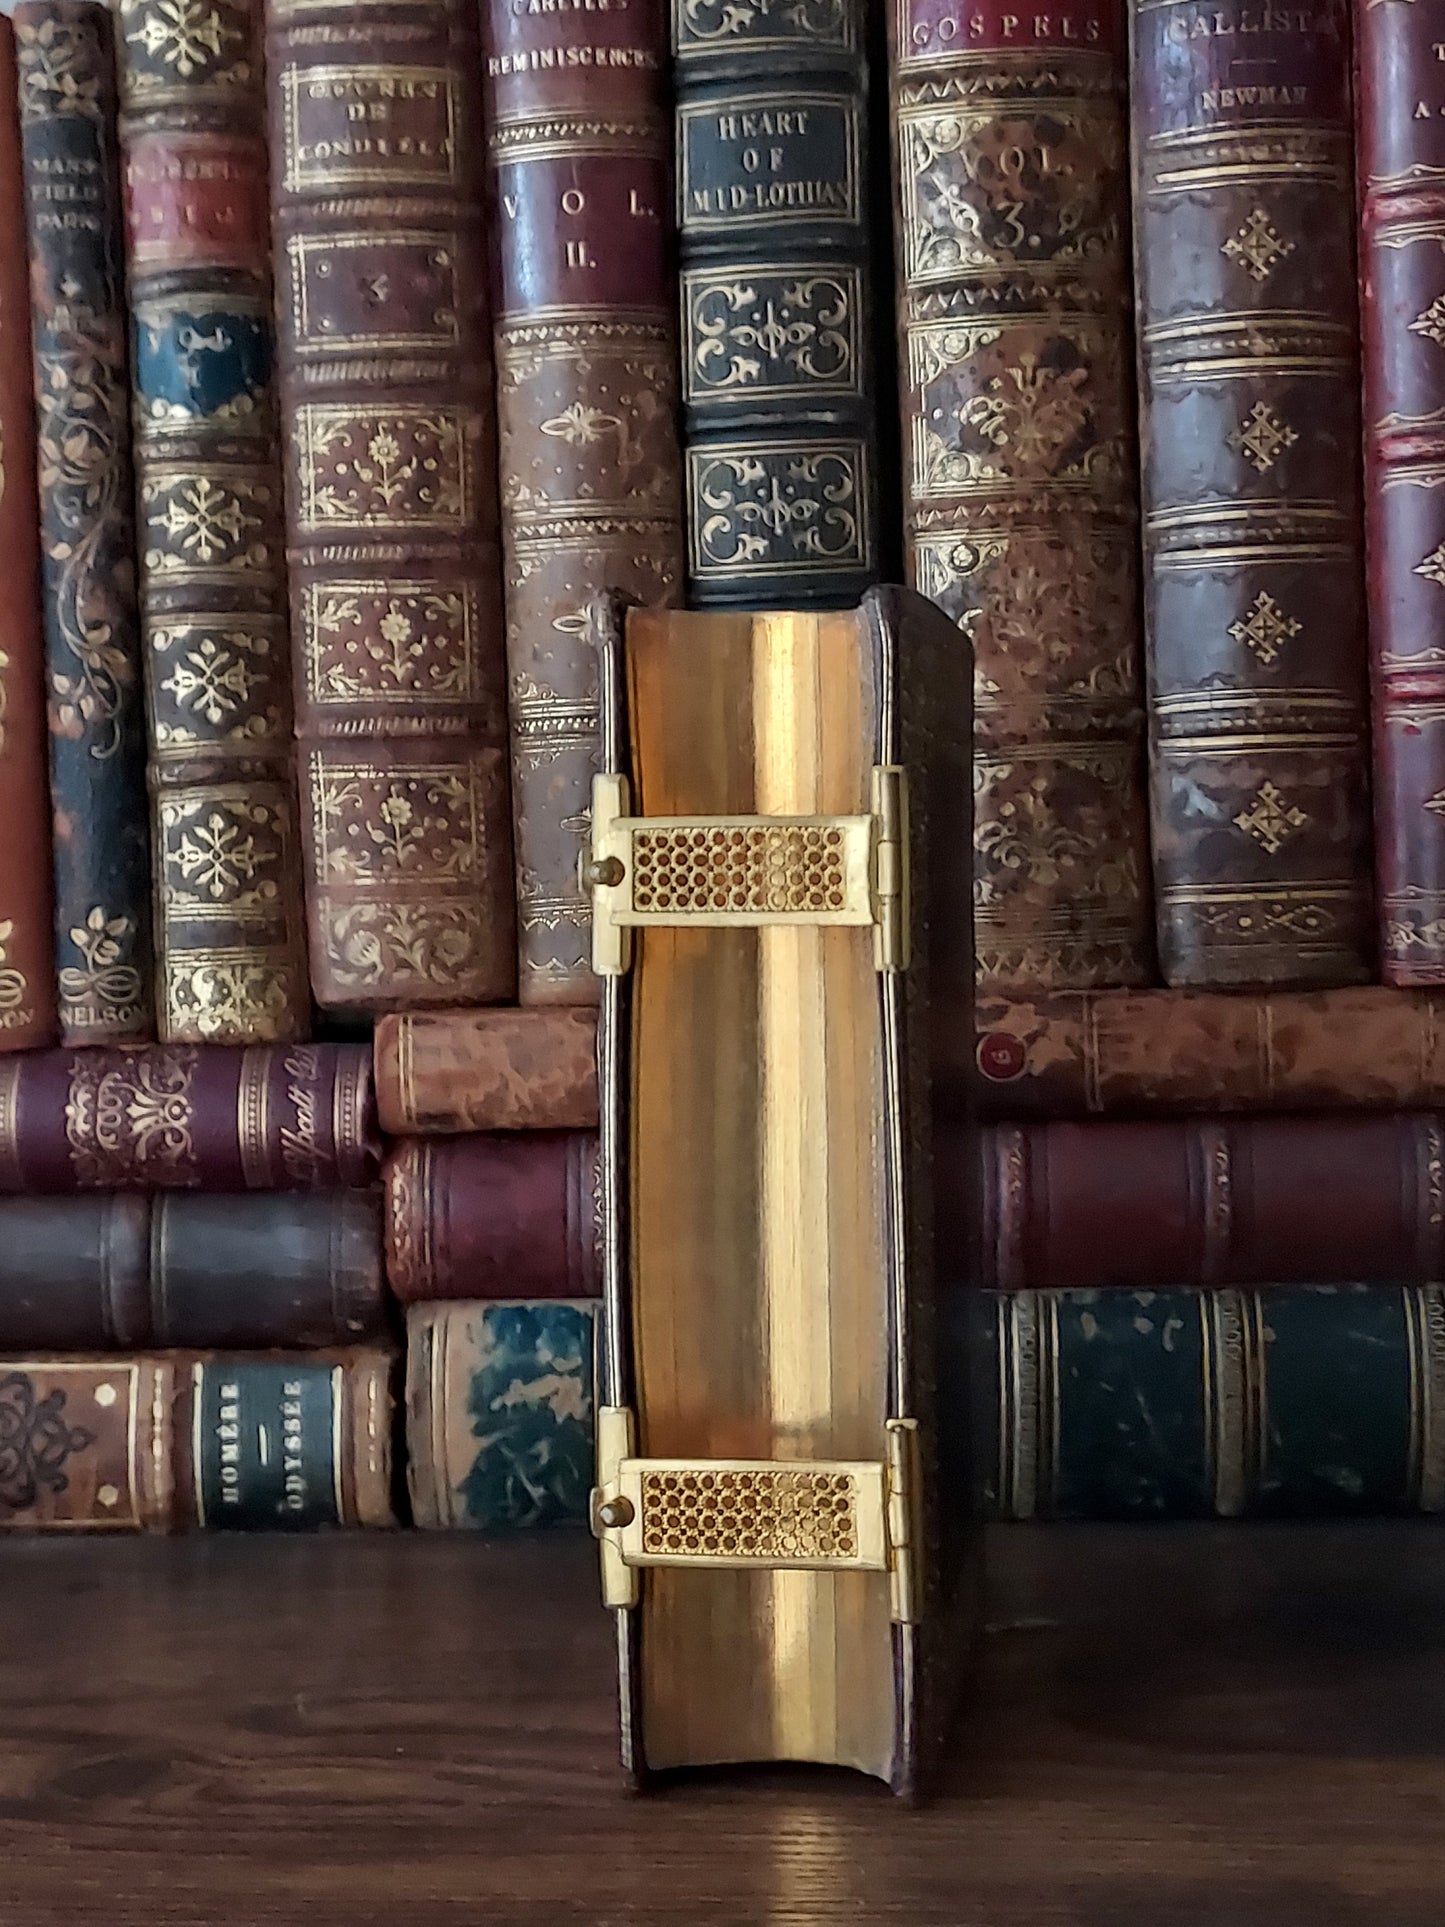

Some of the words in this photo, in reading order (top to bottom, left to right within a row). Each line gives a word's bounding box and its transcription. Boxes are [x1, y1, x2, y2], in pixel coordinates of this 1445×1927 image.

[912, 13, 1100, 45] GOSPELS
[1200, 85, 1308, 112] NEWMAN
[719, 110, 808, 141] HEART
[743, 147, 784, 174] OF
[693, 179, 851, 208] MID-LOTHIAN
[565, 241, 597, 269] II.
